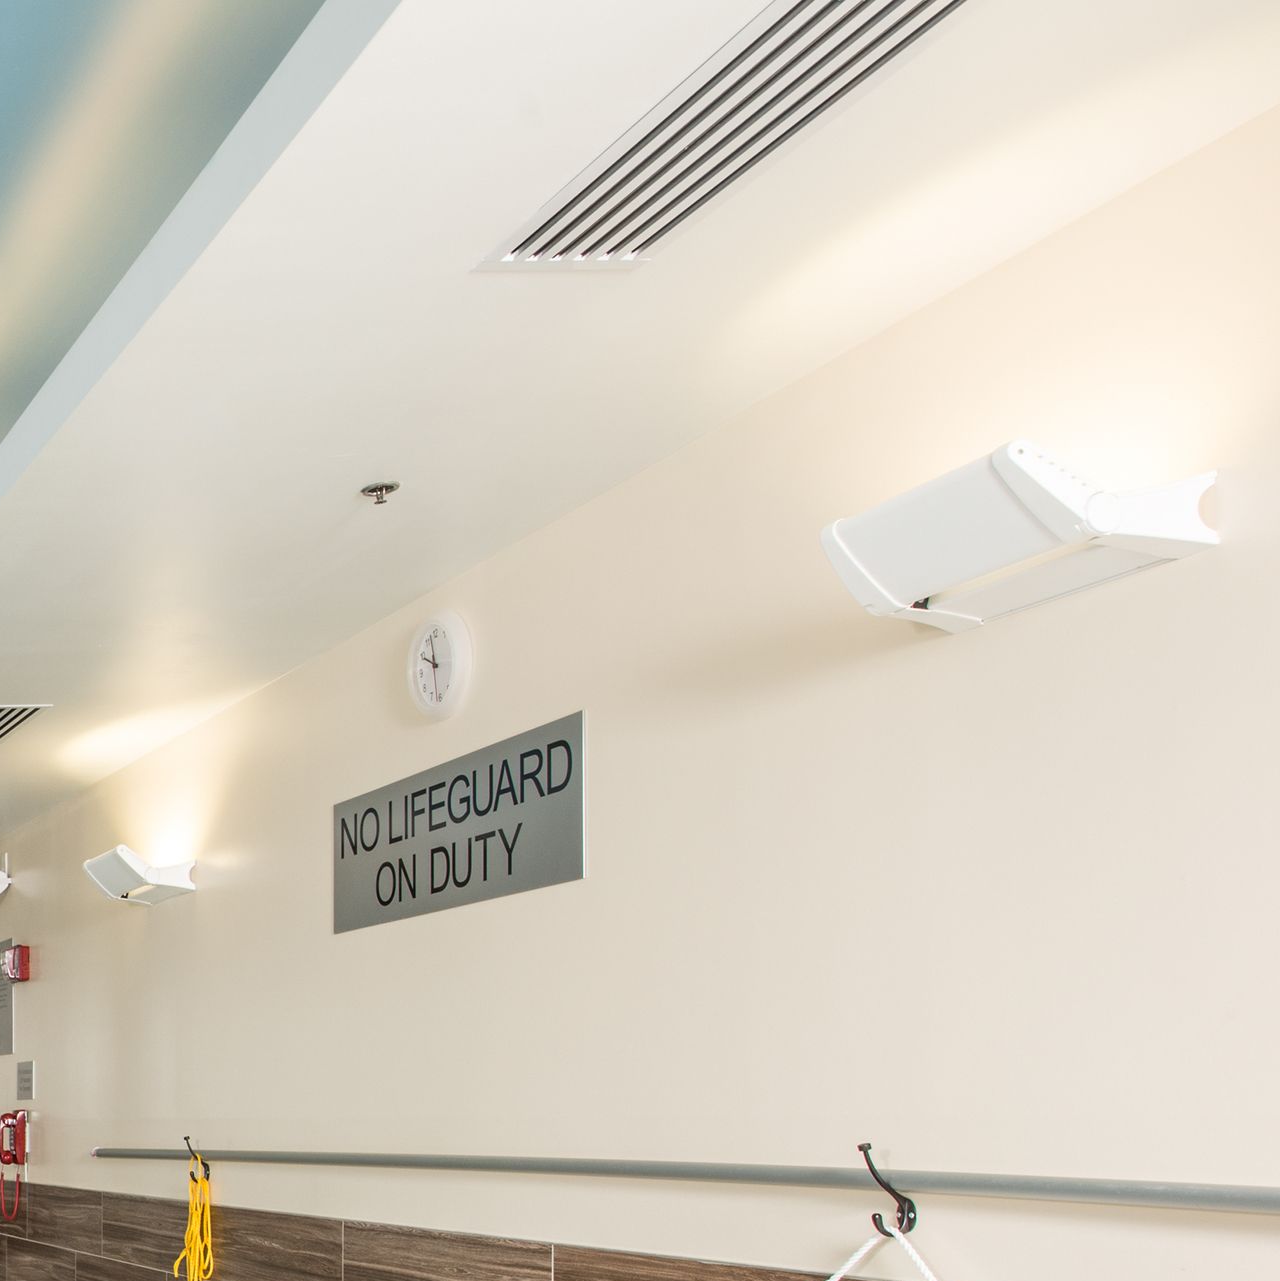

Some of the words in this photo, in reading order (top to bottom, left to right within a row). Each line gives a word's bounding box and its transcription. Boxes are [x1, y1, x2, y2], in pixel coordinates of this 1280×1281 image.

[341, 807, 380, 859] NO
[389, 739, 573, 845] LIFEGUARD
[376, 854, 417, 907] ON
[431, 822, 523, 895] DUTY
